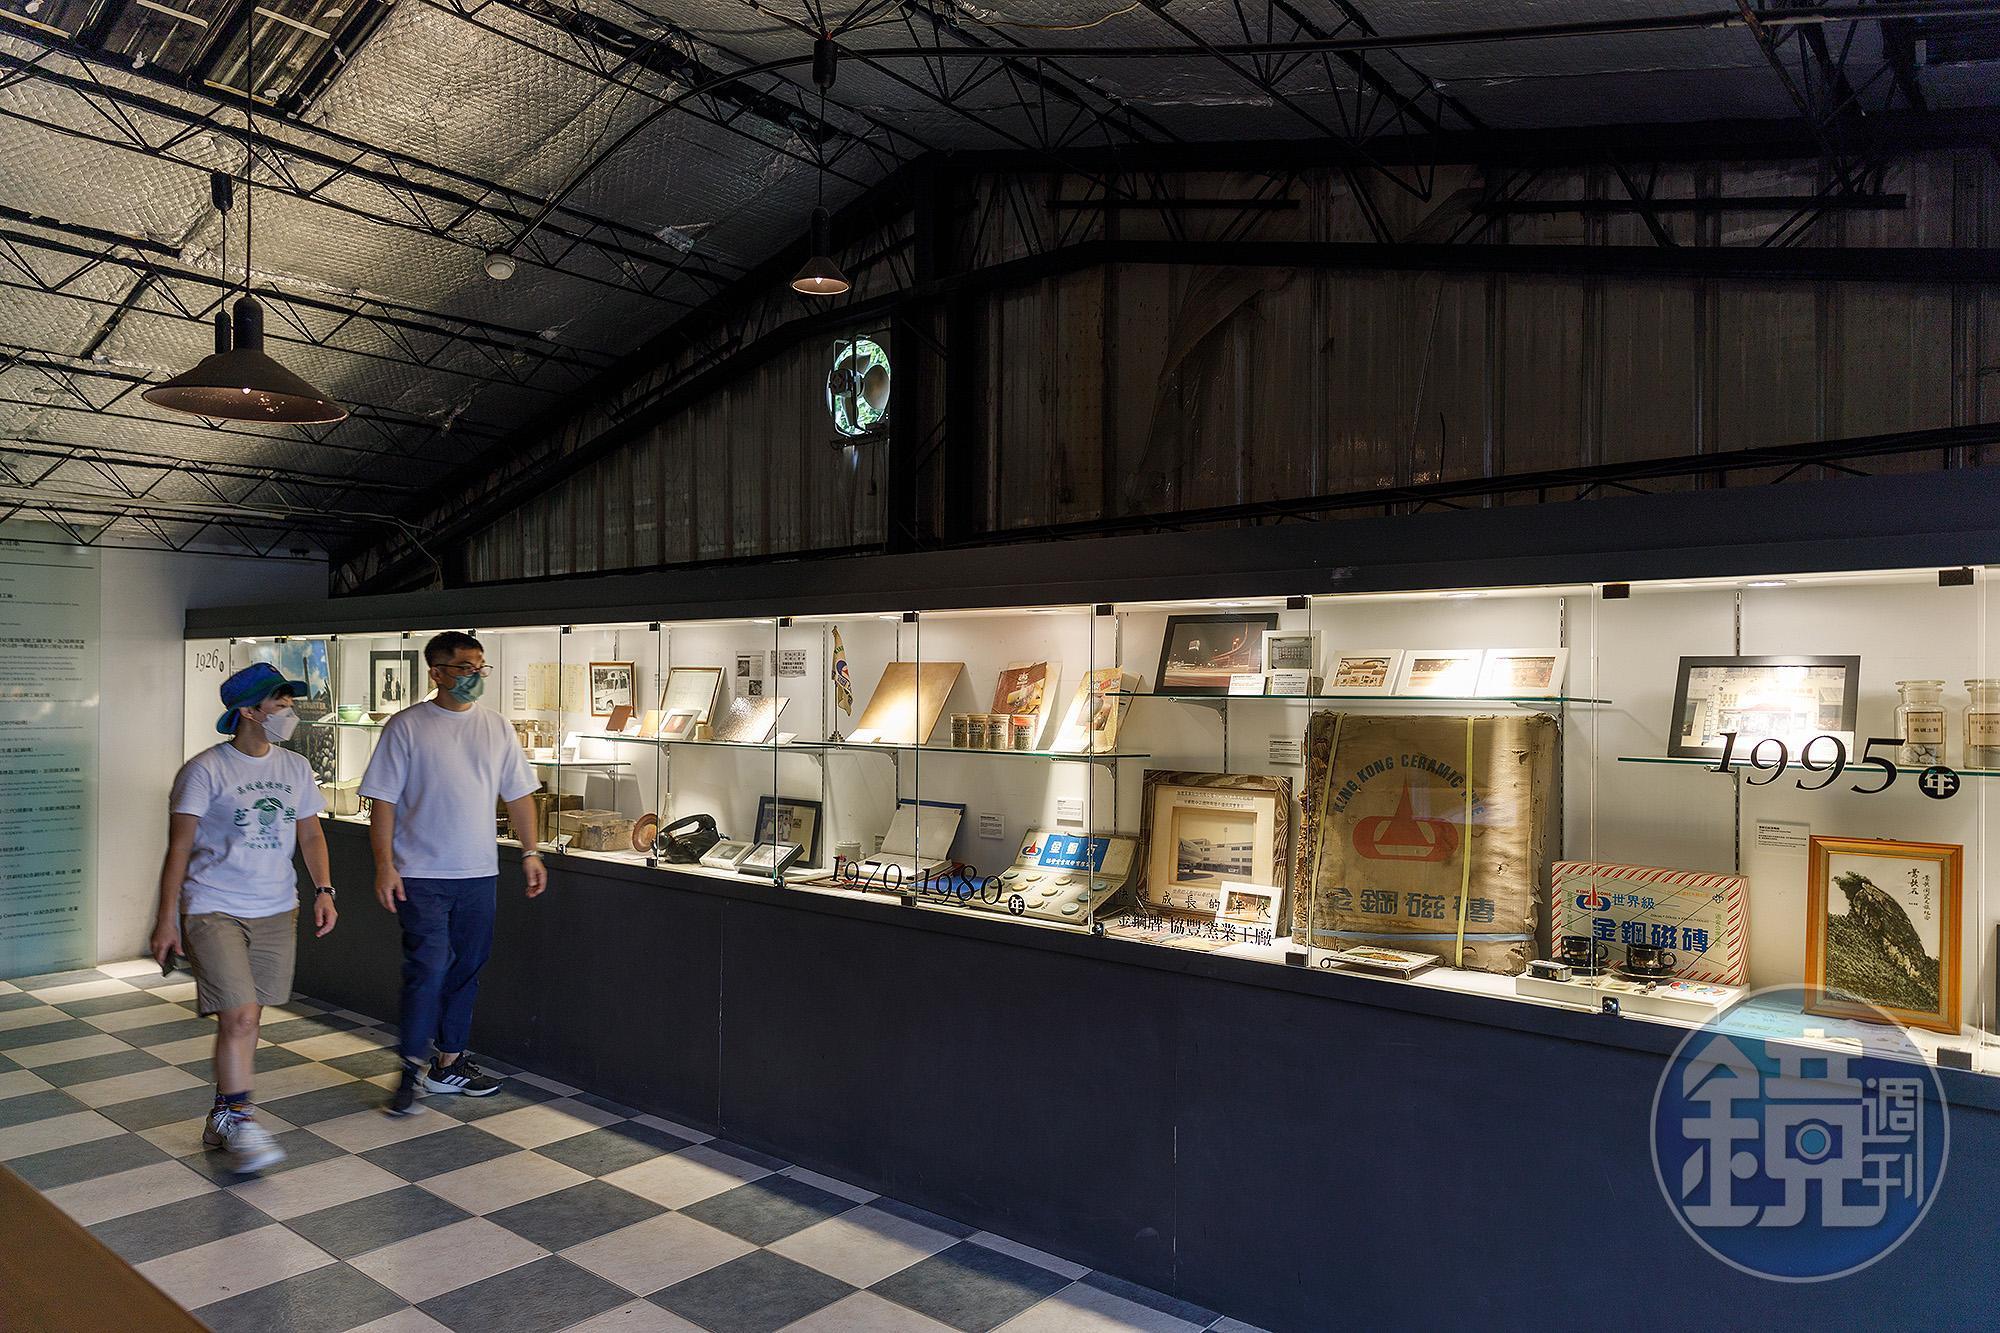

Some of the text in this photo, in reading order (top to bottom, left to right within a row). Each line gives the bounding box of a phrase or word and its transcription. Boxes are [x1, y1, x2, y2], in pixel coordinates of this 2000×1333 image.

[1333, 752, 1464, 813] KING KONG CERAMIC
[1612, 893, 1655, 910] 世界級
